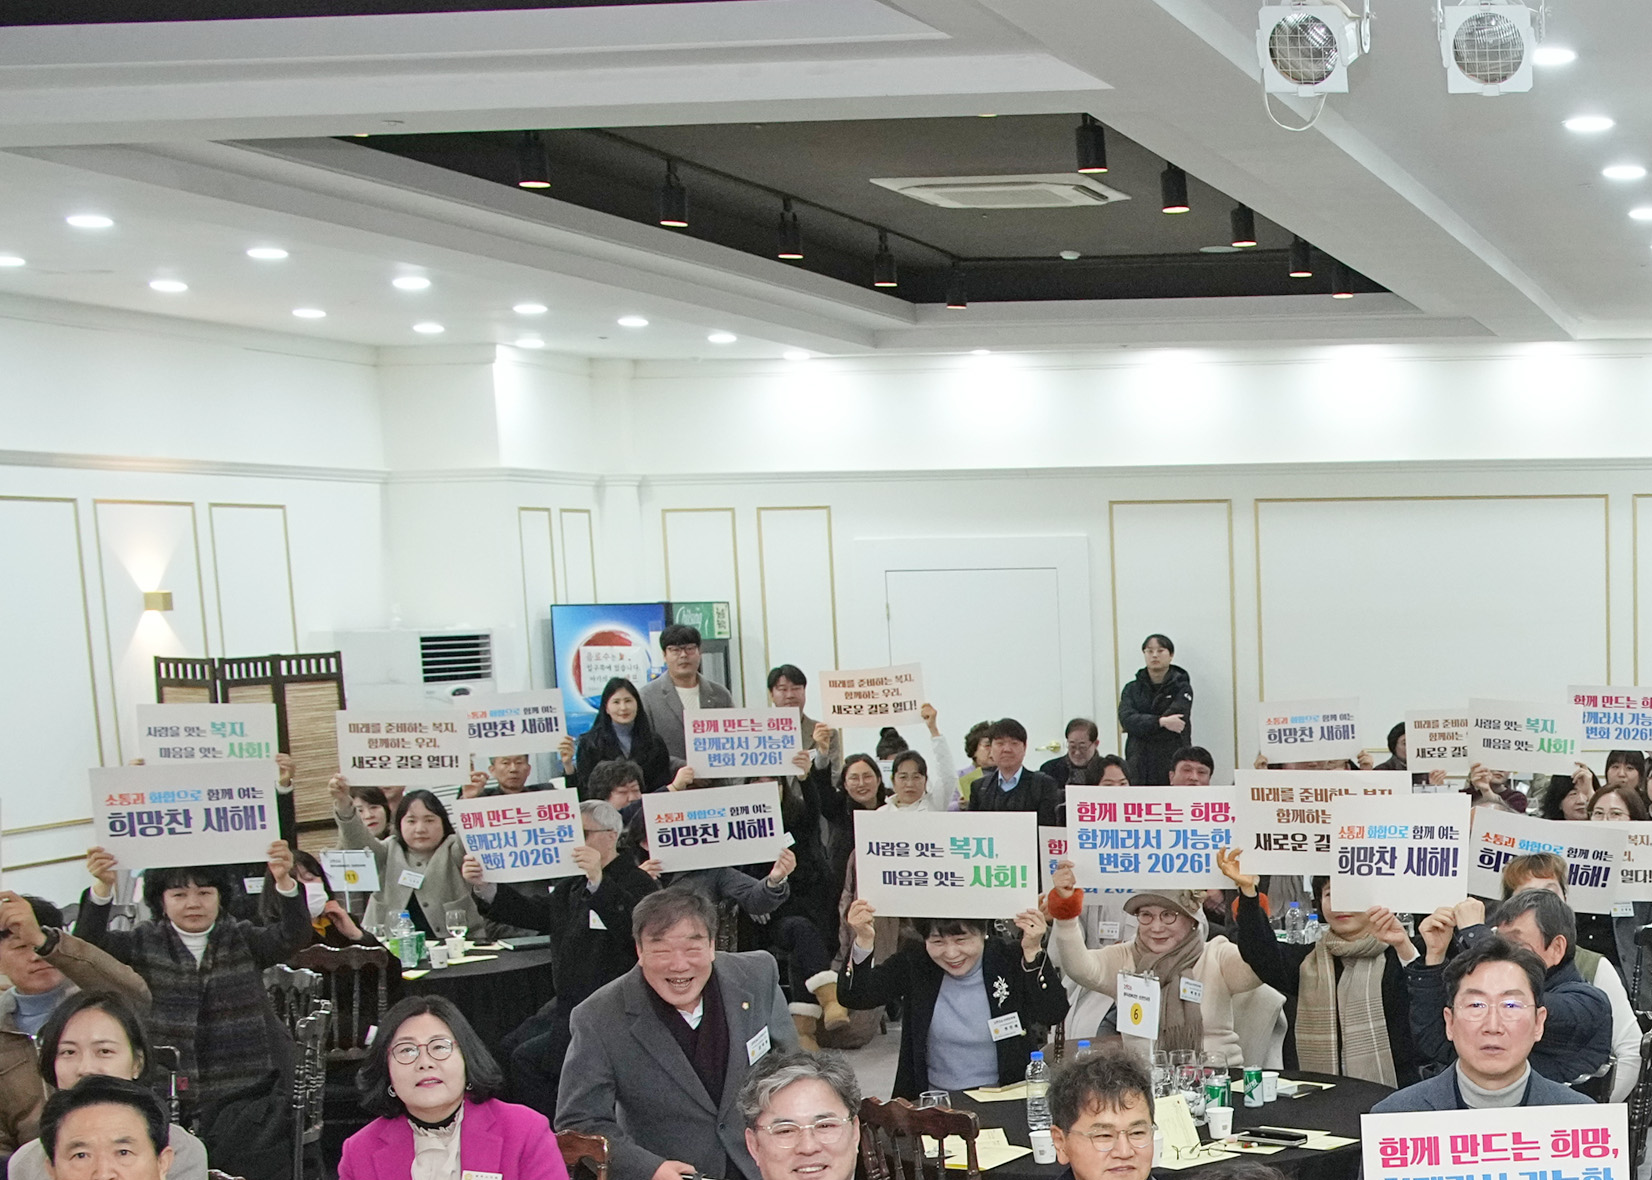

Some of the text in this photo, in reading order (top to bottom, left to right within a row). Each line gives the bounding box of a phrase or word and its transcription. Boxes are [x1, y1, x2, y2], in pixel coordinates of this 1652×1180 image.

[692, 719, 719, 733] 함께
[1267, 724, 1355, 744] 희망찬 새해!
[1586, 727, 1652, 741] 변화 2026!
[227, 742, 270, 758] 사회!
[708, 752, 782, 767] 변화 2026!
[105, 787, 264, 806] 소통과 화합으로 함께 여는
[108, 805, 266, 837] 희망찬 새해!
[461, 803, 576, 829] 함께 만드는 희망,
[654, 804, 772, 822] 소통과 화합으로 함께 여는
[1077, 802, 1236, 823] 함께 만드는 희망,
[466, 825, 574, 851] 함께라서 가능한
[658, 818, 775, 848] 희망찬 새해!
[1078, 829, 1231, 850] 함께라서 가능한
[1254, 833, 1308, 851] 새로운
[1338, 825, 1459, 840] 소통과 화합으로 함께 여는
[867, 837, 998, 859] 사람을 잇는 복지,
[1567, 847, 1613, 862] 함께 여는
[481, 848, 560, 870] 변화 2026!
[1099, 853, 1210, 873] 변화 2026!
[1338, 846, 1459, 877] 희망찬 새해!
[882, 866, 1027, 888] 마음을 잇는 사회!
[1134, 1009, 1138, 1020] 6
[1379, 1128, 1618, 1168] 함께 만드는 희망,
